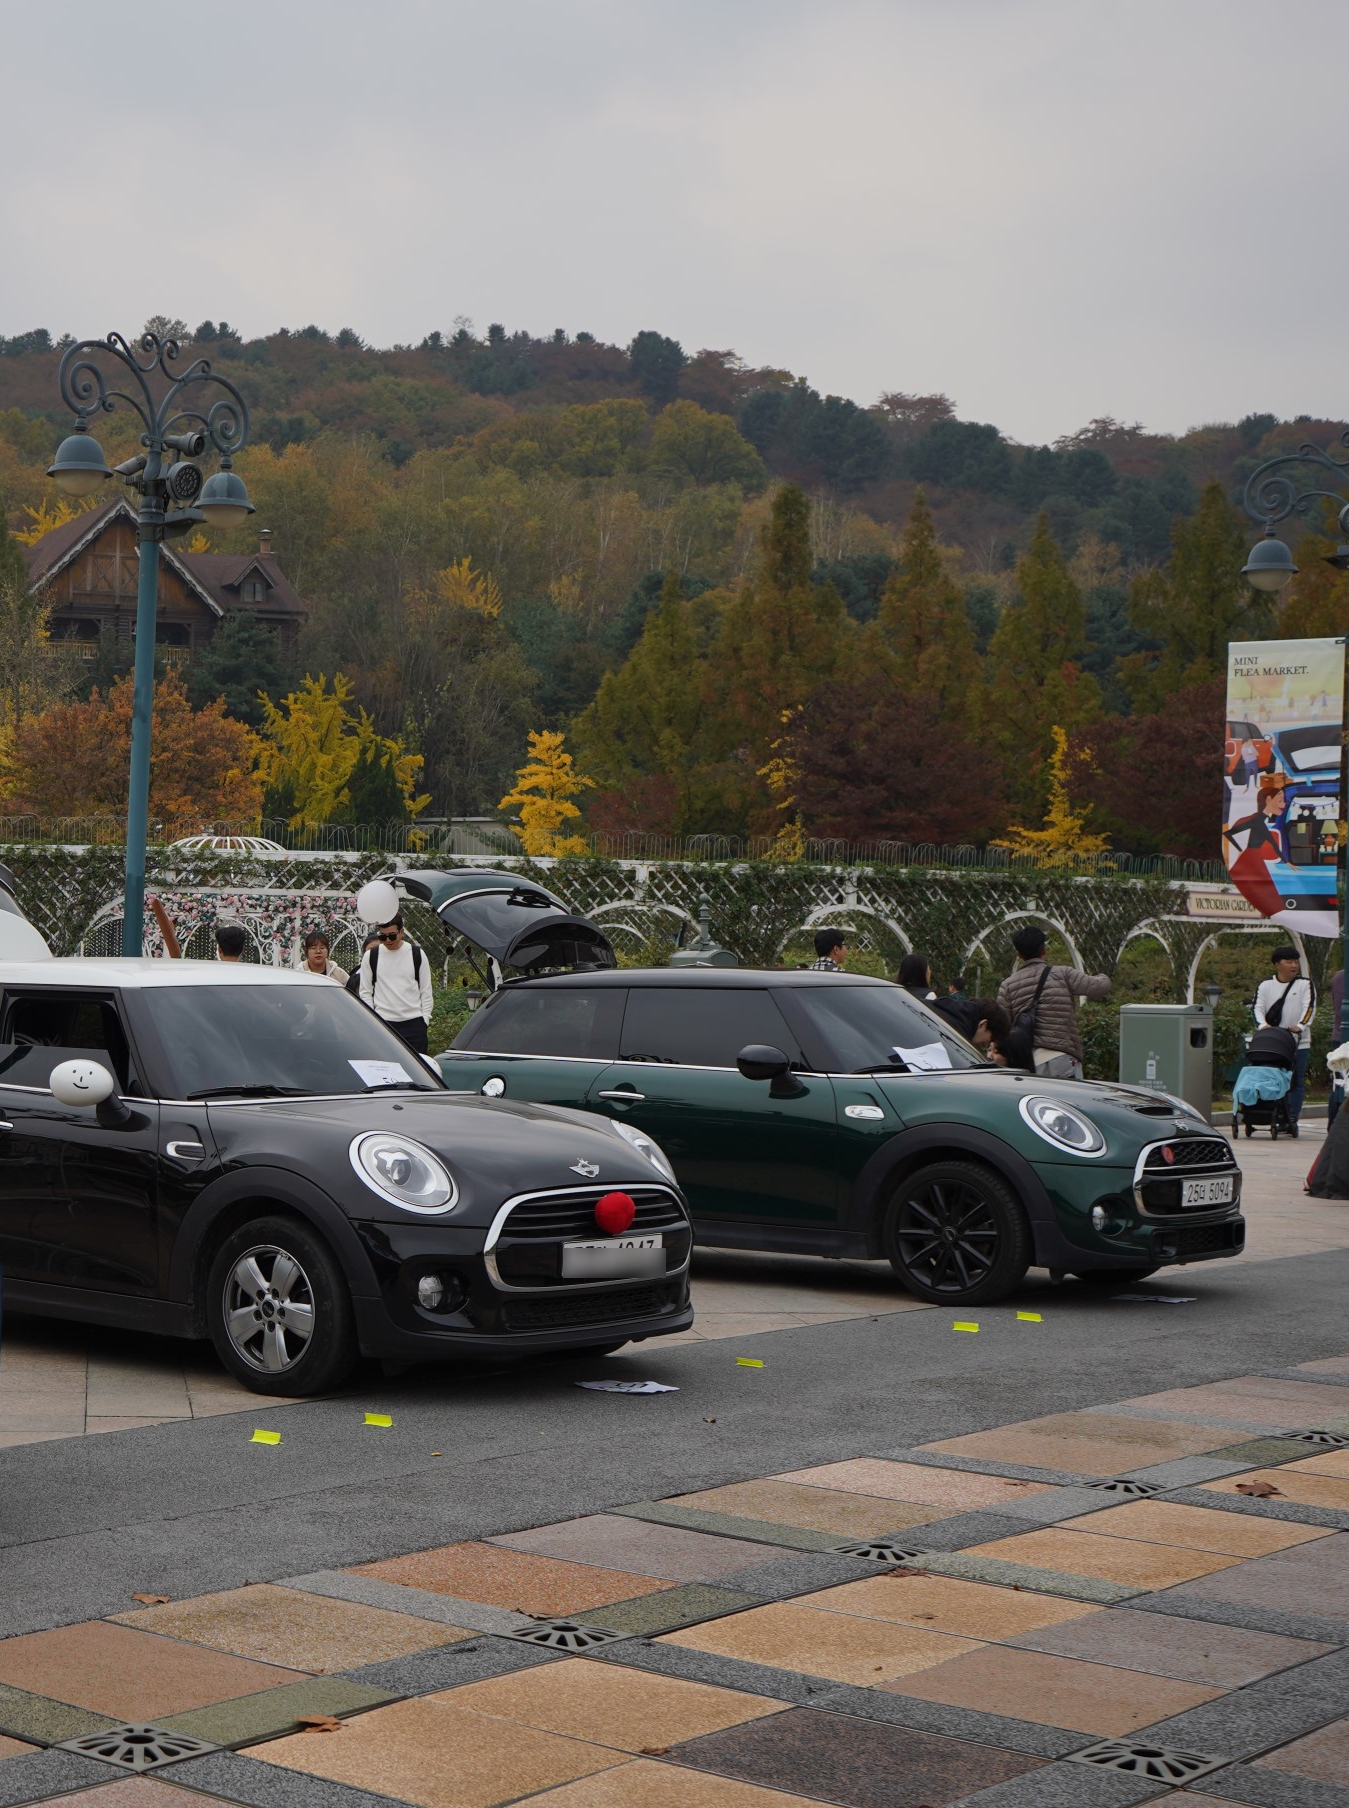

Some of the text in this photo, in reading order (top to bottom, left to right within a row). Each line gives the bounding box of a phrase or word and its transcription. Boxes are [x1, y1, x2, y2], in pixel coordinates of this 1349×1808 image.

[1234, 656, 1258, 666] MINI
[1234, 665, 1309, 677] FLEA MARKET.
[1195, 897, 1229, 911] VICTORIAN
[1208, 1181, 1230, 1201] 5094
